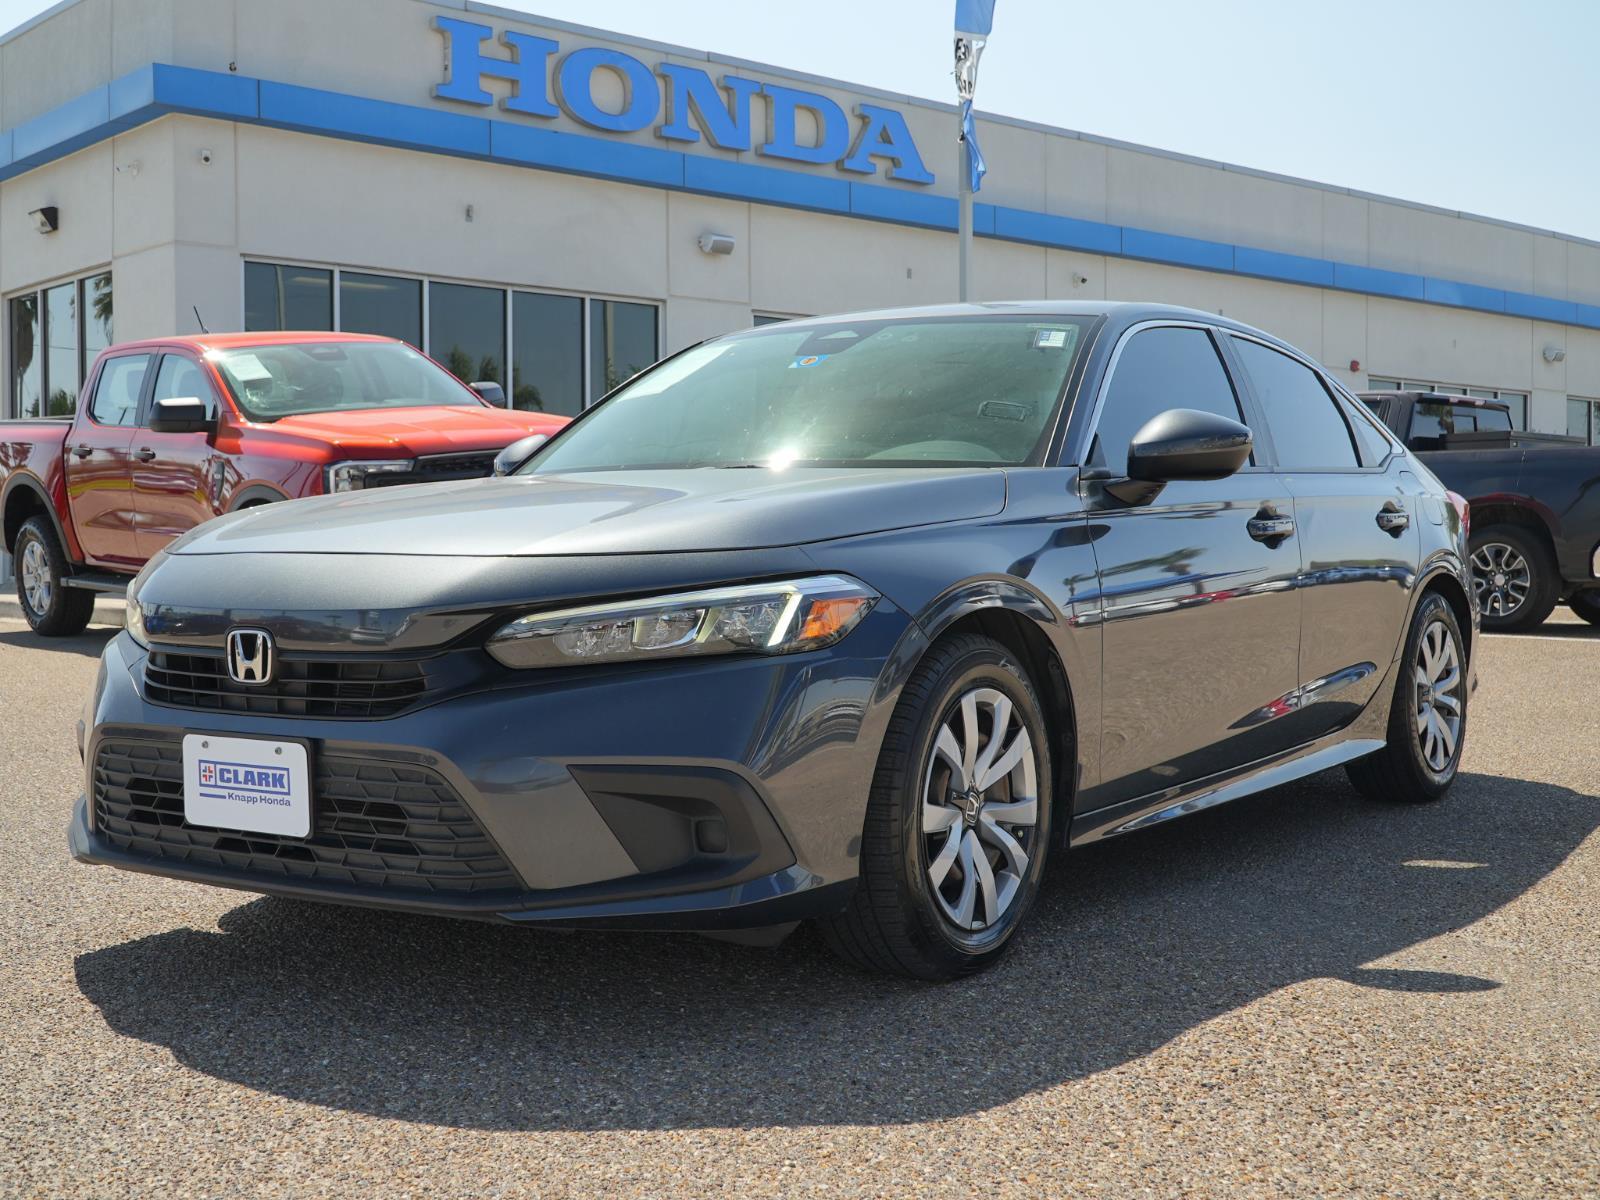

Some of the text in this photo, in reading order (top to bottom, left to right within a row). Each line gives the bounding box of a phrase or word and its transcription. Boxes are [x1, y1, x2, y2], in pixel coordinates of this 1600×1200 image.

[431, 16, 935, 185] HONDA
[219, 768, 285, 788] CLARK
[228, 793, 290, 806] Knapp Honda
